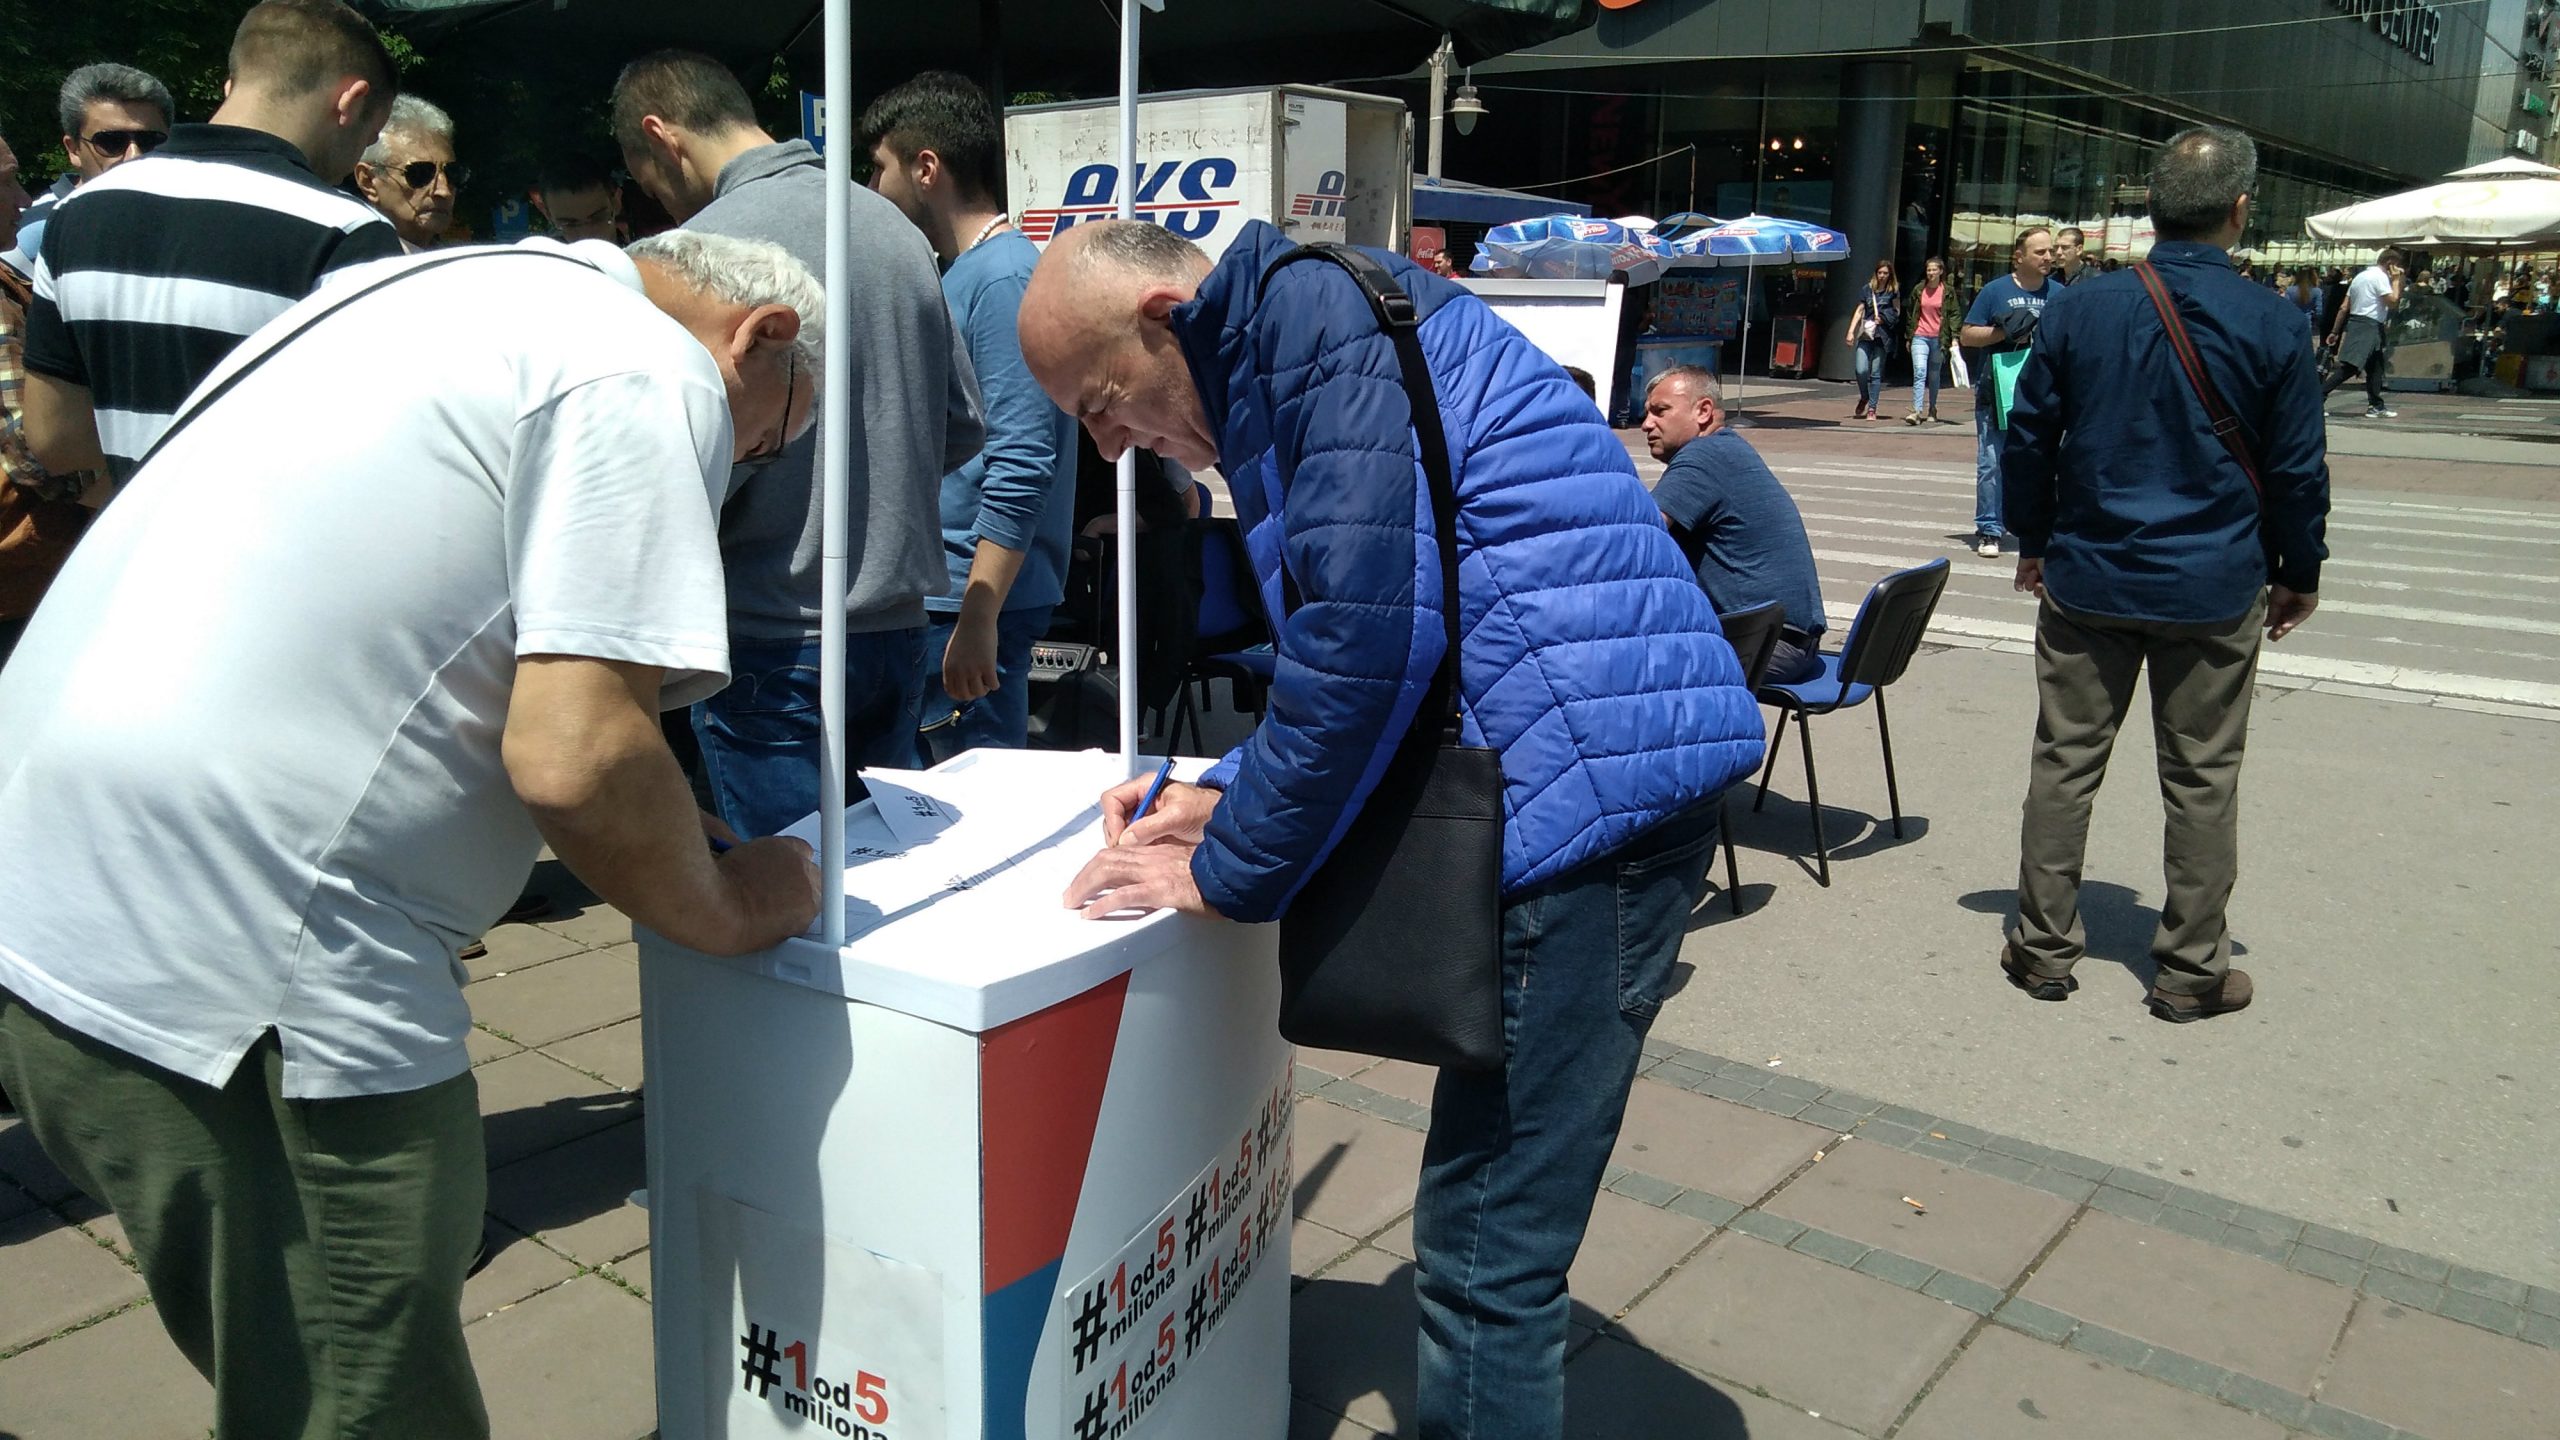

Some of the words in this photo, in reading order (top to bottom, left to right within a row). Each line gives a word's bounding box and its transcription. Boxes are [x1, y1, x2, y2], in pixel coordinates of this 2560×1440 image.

[2007, 297, 2026, 307] TOM
[1208, 1176, 1252, 1243] miliona
[1109, 1267, 1176, 1346] miliona
[1207, 1259, 1251, 1332] miliona
[1110, 1361, 1176, 1440] miliona
